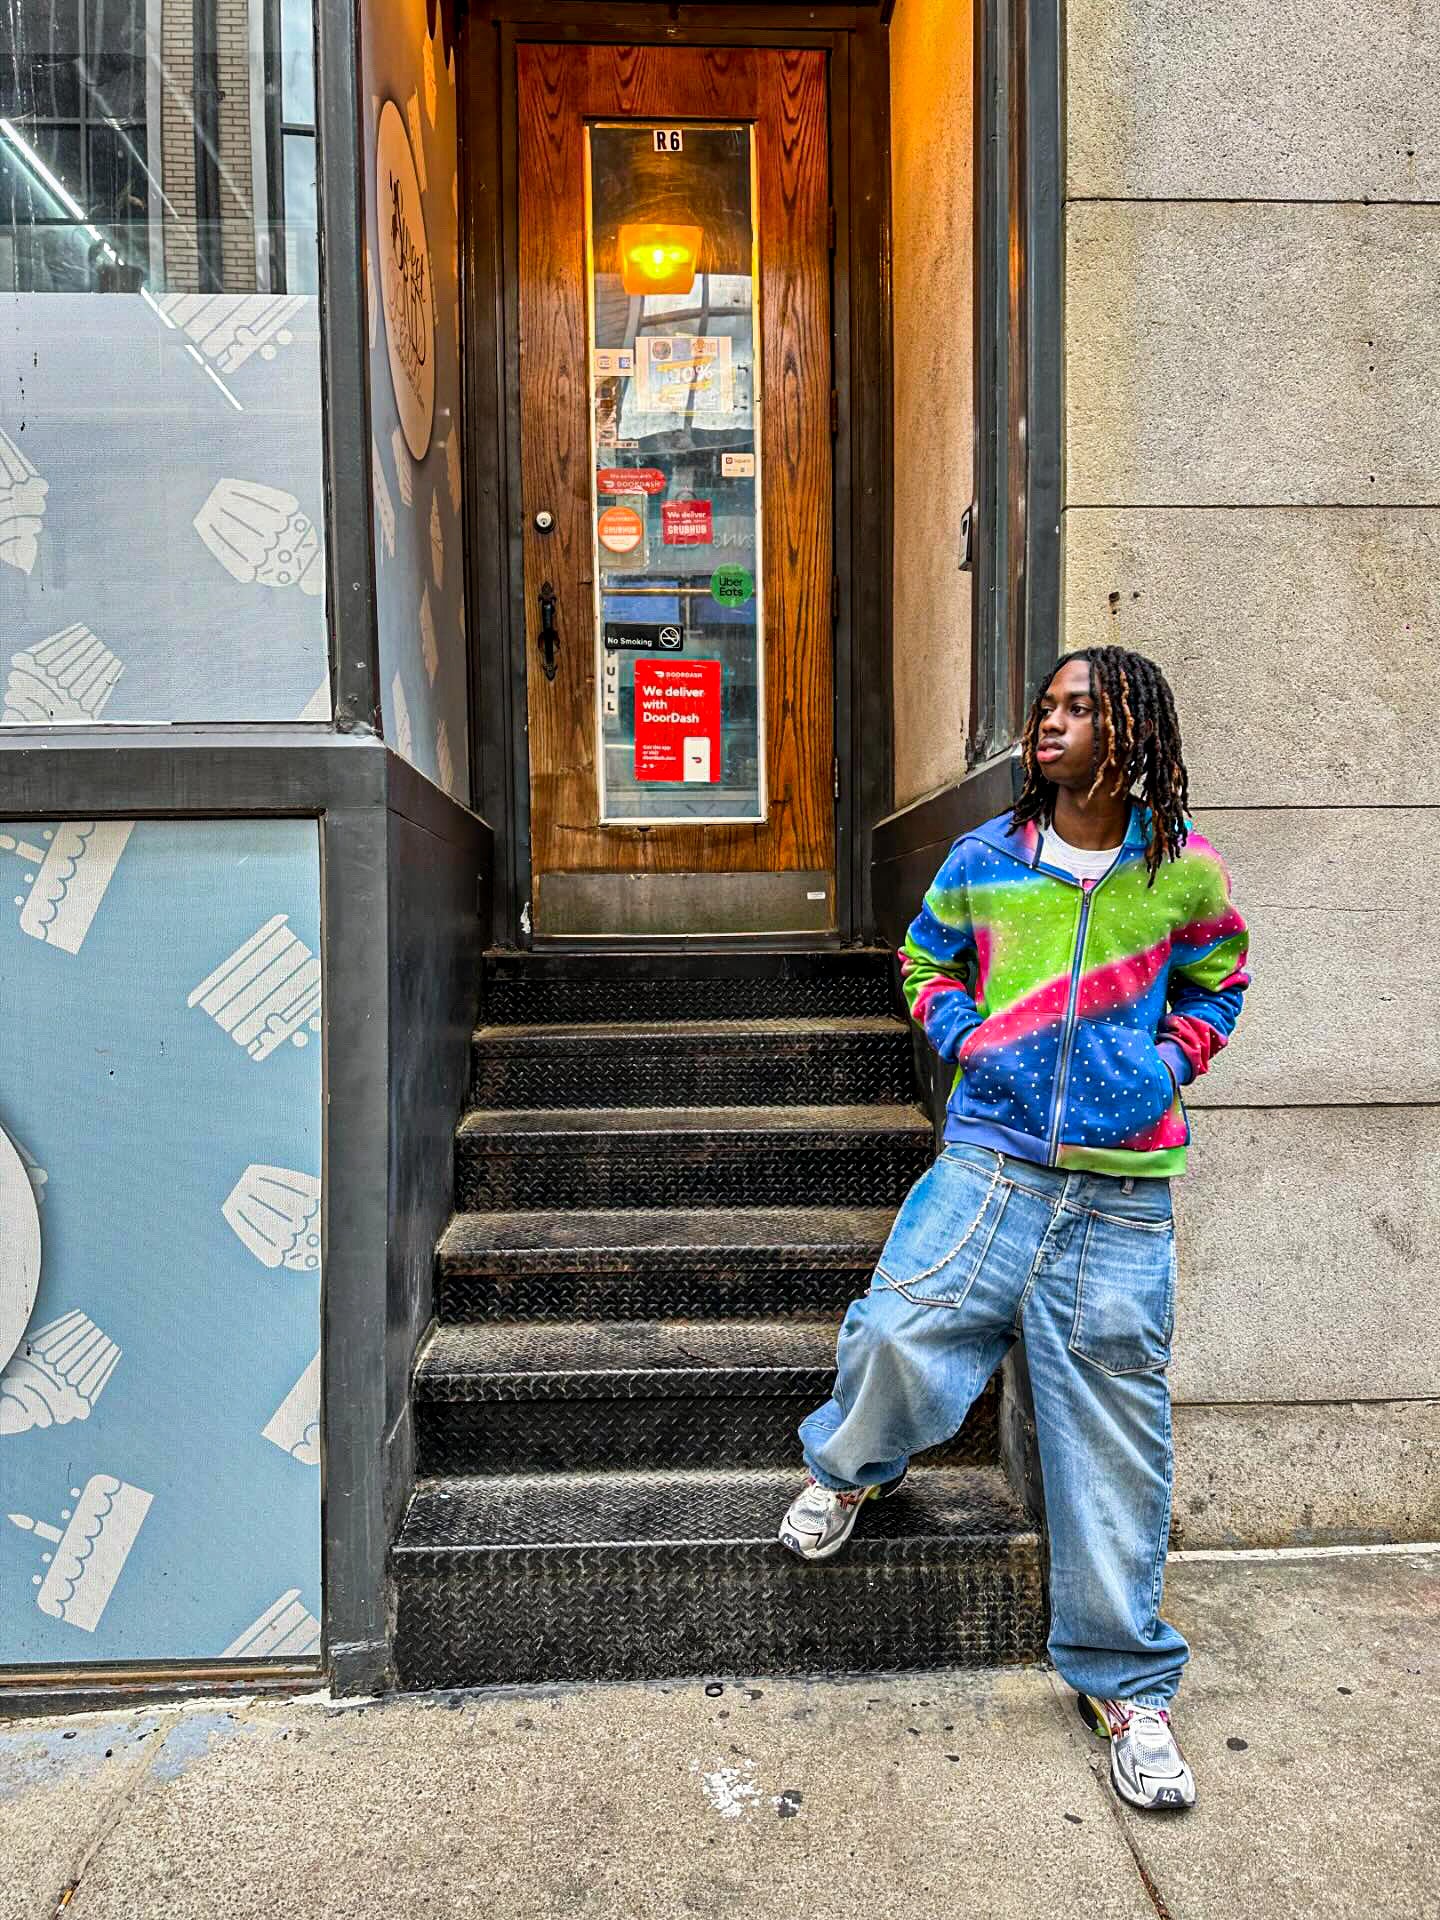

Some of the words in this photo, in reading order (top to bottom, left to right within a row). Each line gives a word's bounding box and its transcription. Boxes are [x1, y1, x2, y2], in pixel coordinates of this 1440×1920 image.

[681, 510, 706, 518] deliver
[668, 525, 707, 535] GRUBHUB
[719, 576, 743, 587] Uber
[719, 587, 743, 597] Eats
[607, 637, 619, 645] No
[620, 637, 653, 648] Smoking
[665, 671, 703, 679] DOORDASH
[642, 685, 663, 697] We
[665, 685, 705, 698] deliver
[642, 699, 668, 710] with
[643, 711, 700, 724] DoorDash
[1162, 1790, 1177, 1802] 42
